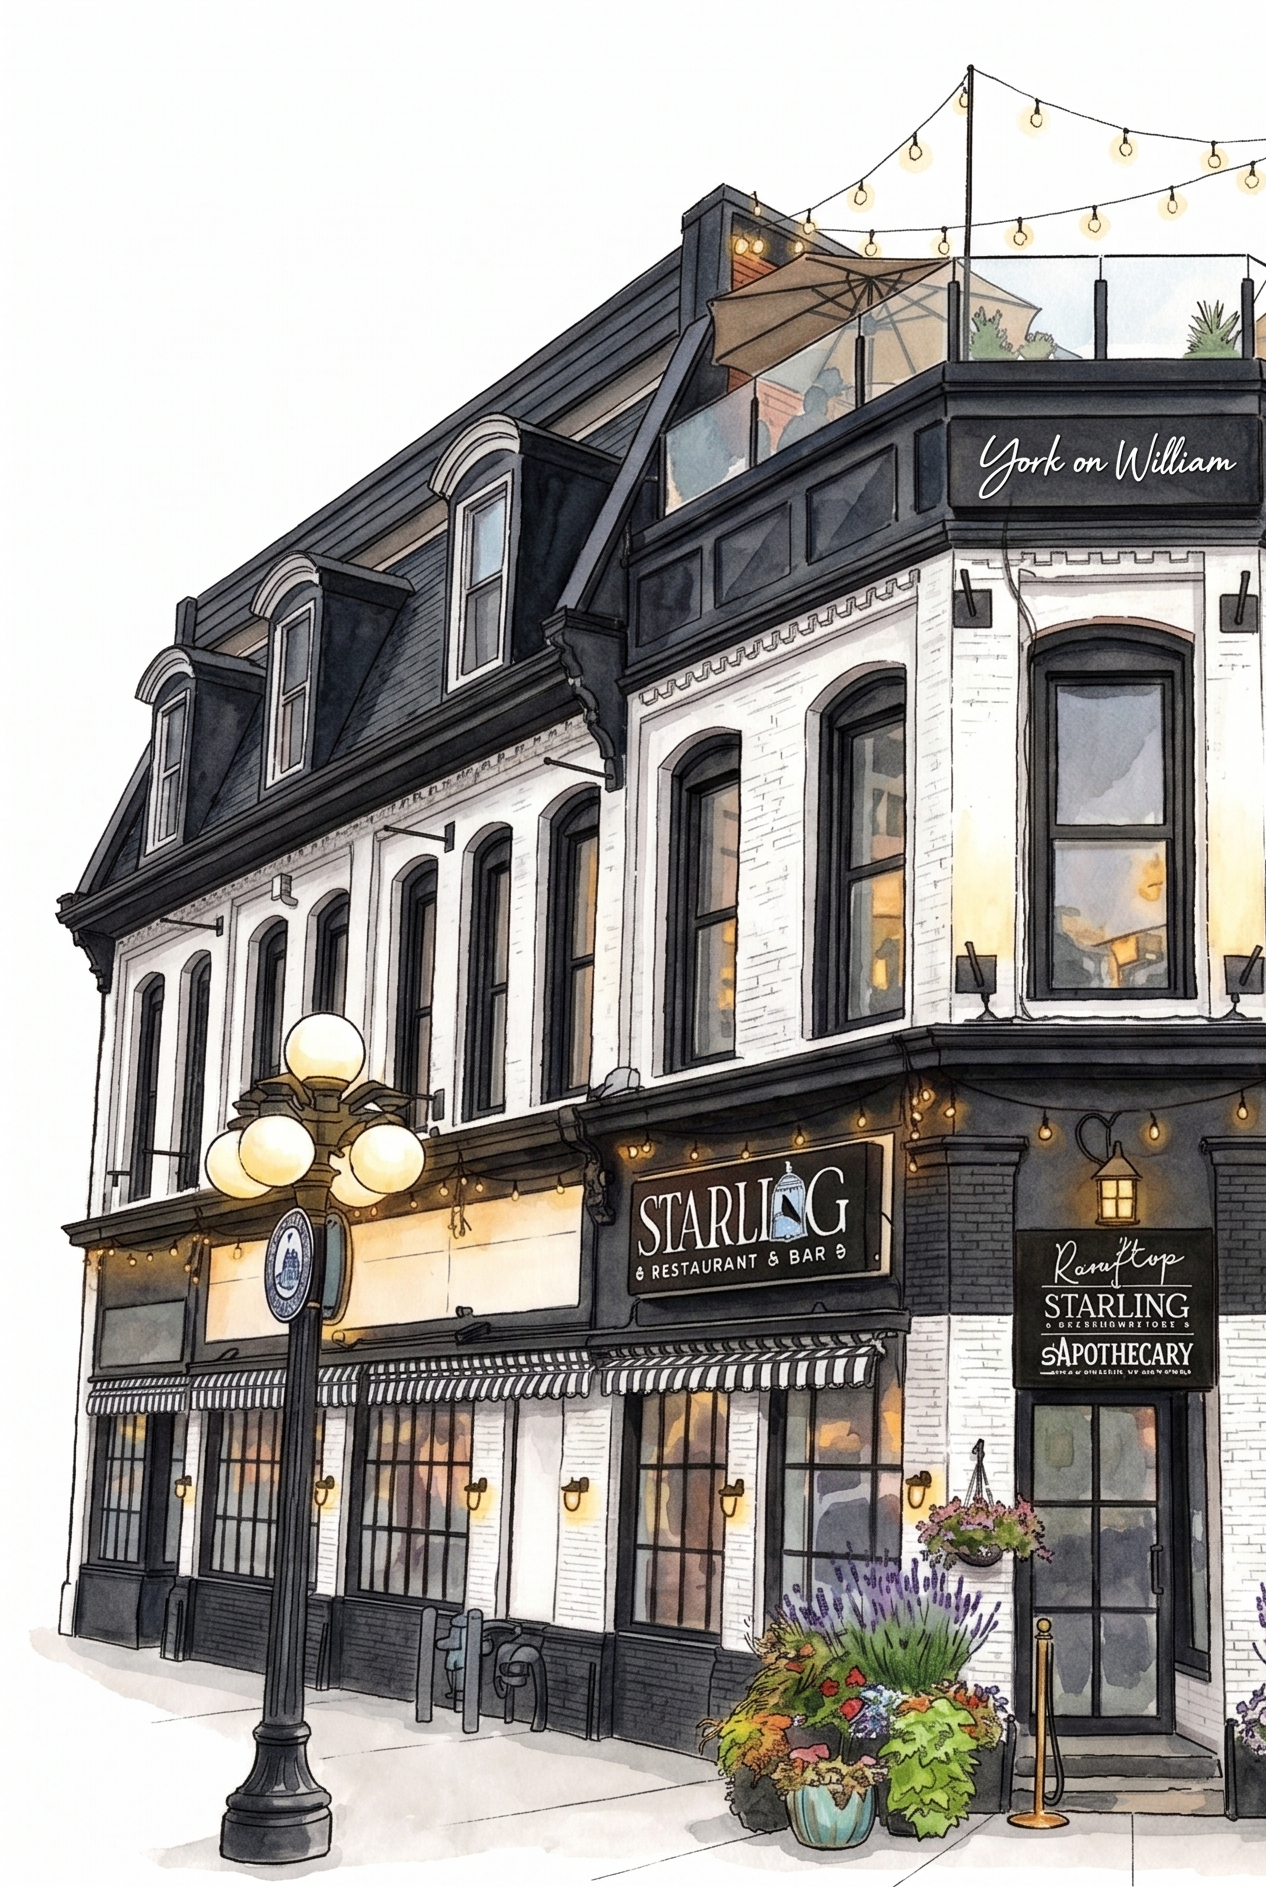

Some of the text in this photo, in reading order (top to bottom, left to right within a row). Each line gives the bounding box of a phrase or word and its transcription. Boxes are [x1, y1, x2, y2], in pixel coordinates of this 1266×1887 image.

[978, 432, 1238, 500] York on William
[638, 1166, 849, 1257] STARLIG
[651, 1246, 826, 1280] RESTAURANT & BAR
[1044, 1292, 1190, 1319] STARLING
